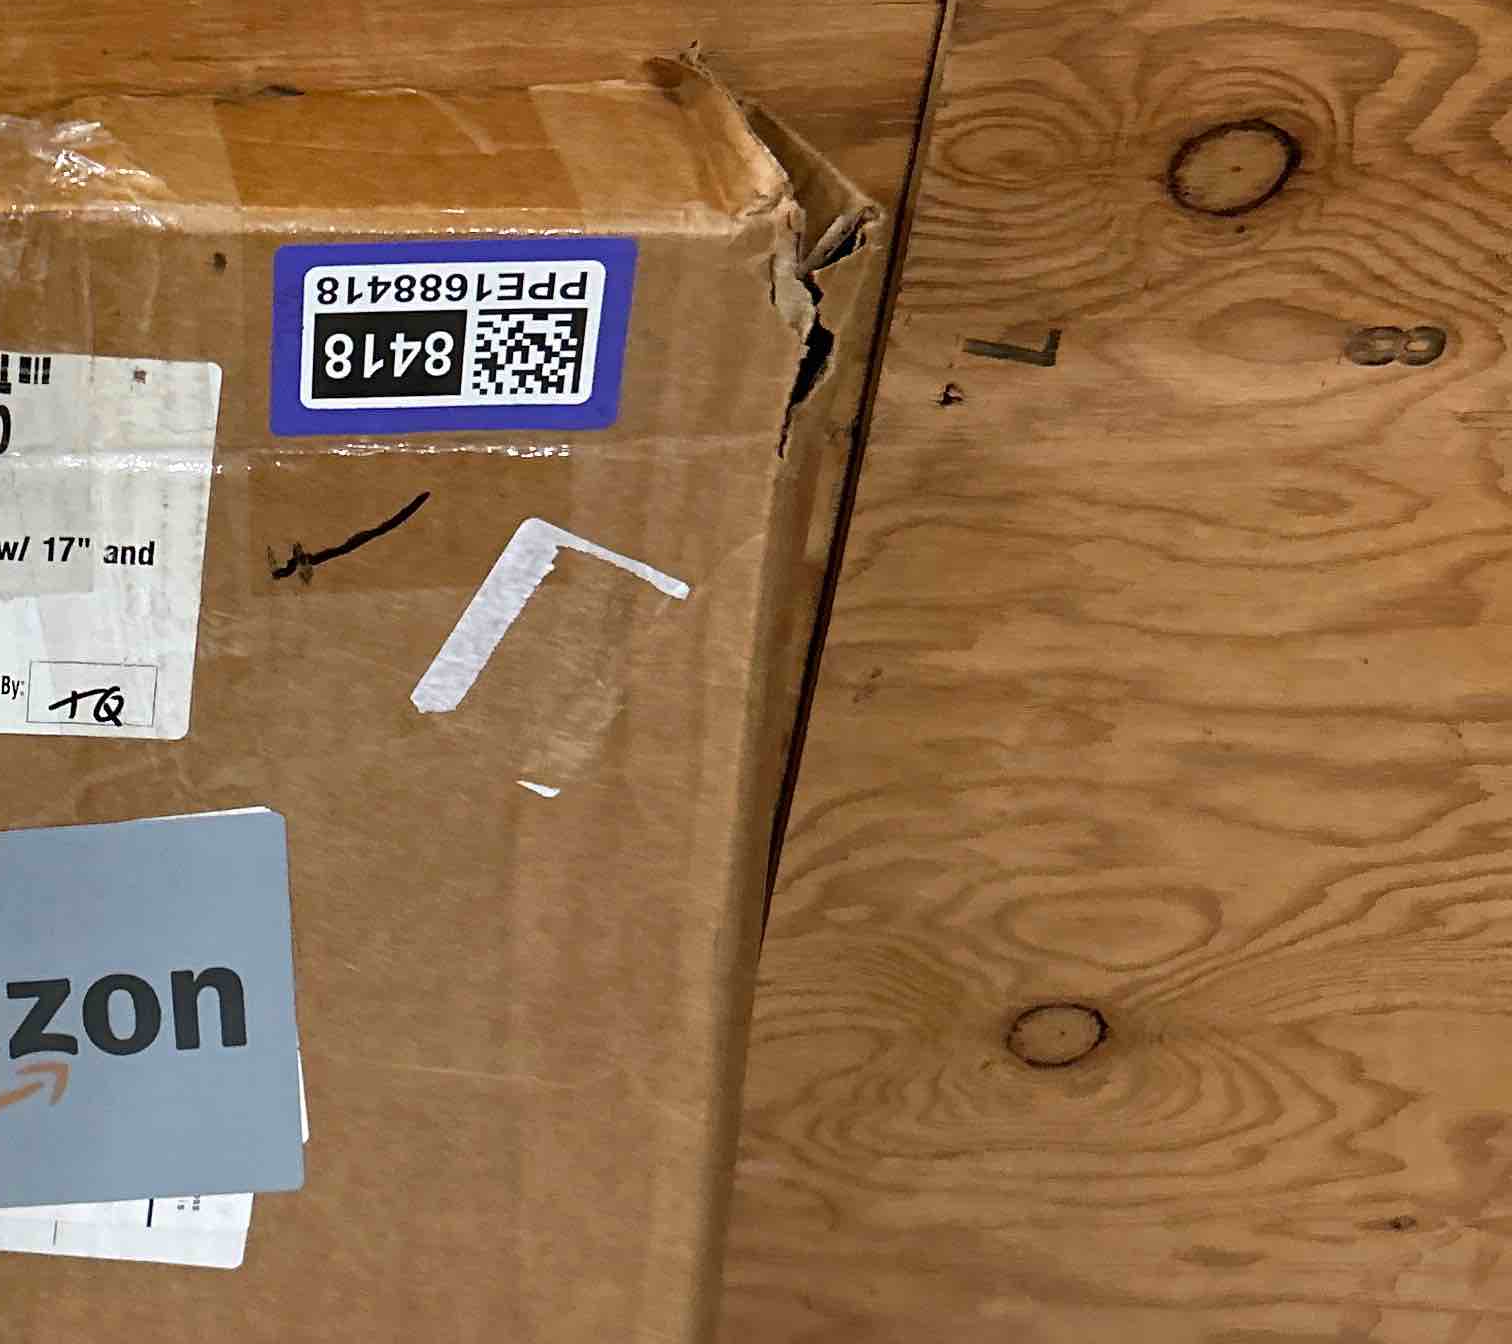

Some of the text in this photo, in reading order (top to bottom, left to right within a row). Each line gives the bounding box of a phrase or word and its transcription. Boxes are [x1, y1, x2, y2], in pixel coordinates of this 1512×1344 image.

[316, 271, 587, 305] PPE1688418
[324, 331, 454, 379] 8418
[43, 536, 90, 562] 17"
[104, 541, 155, 565] and
[1, 675, 24, 700] By:
